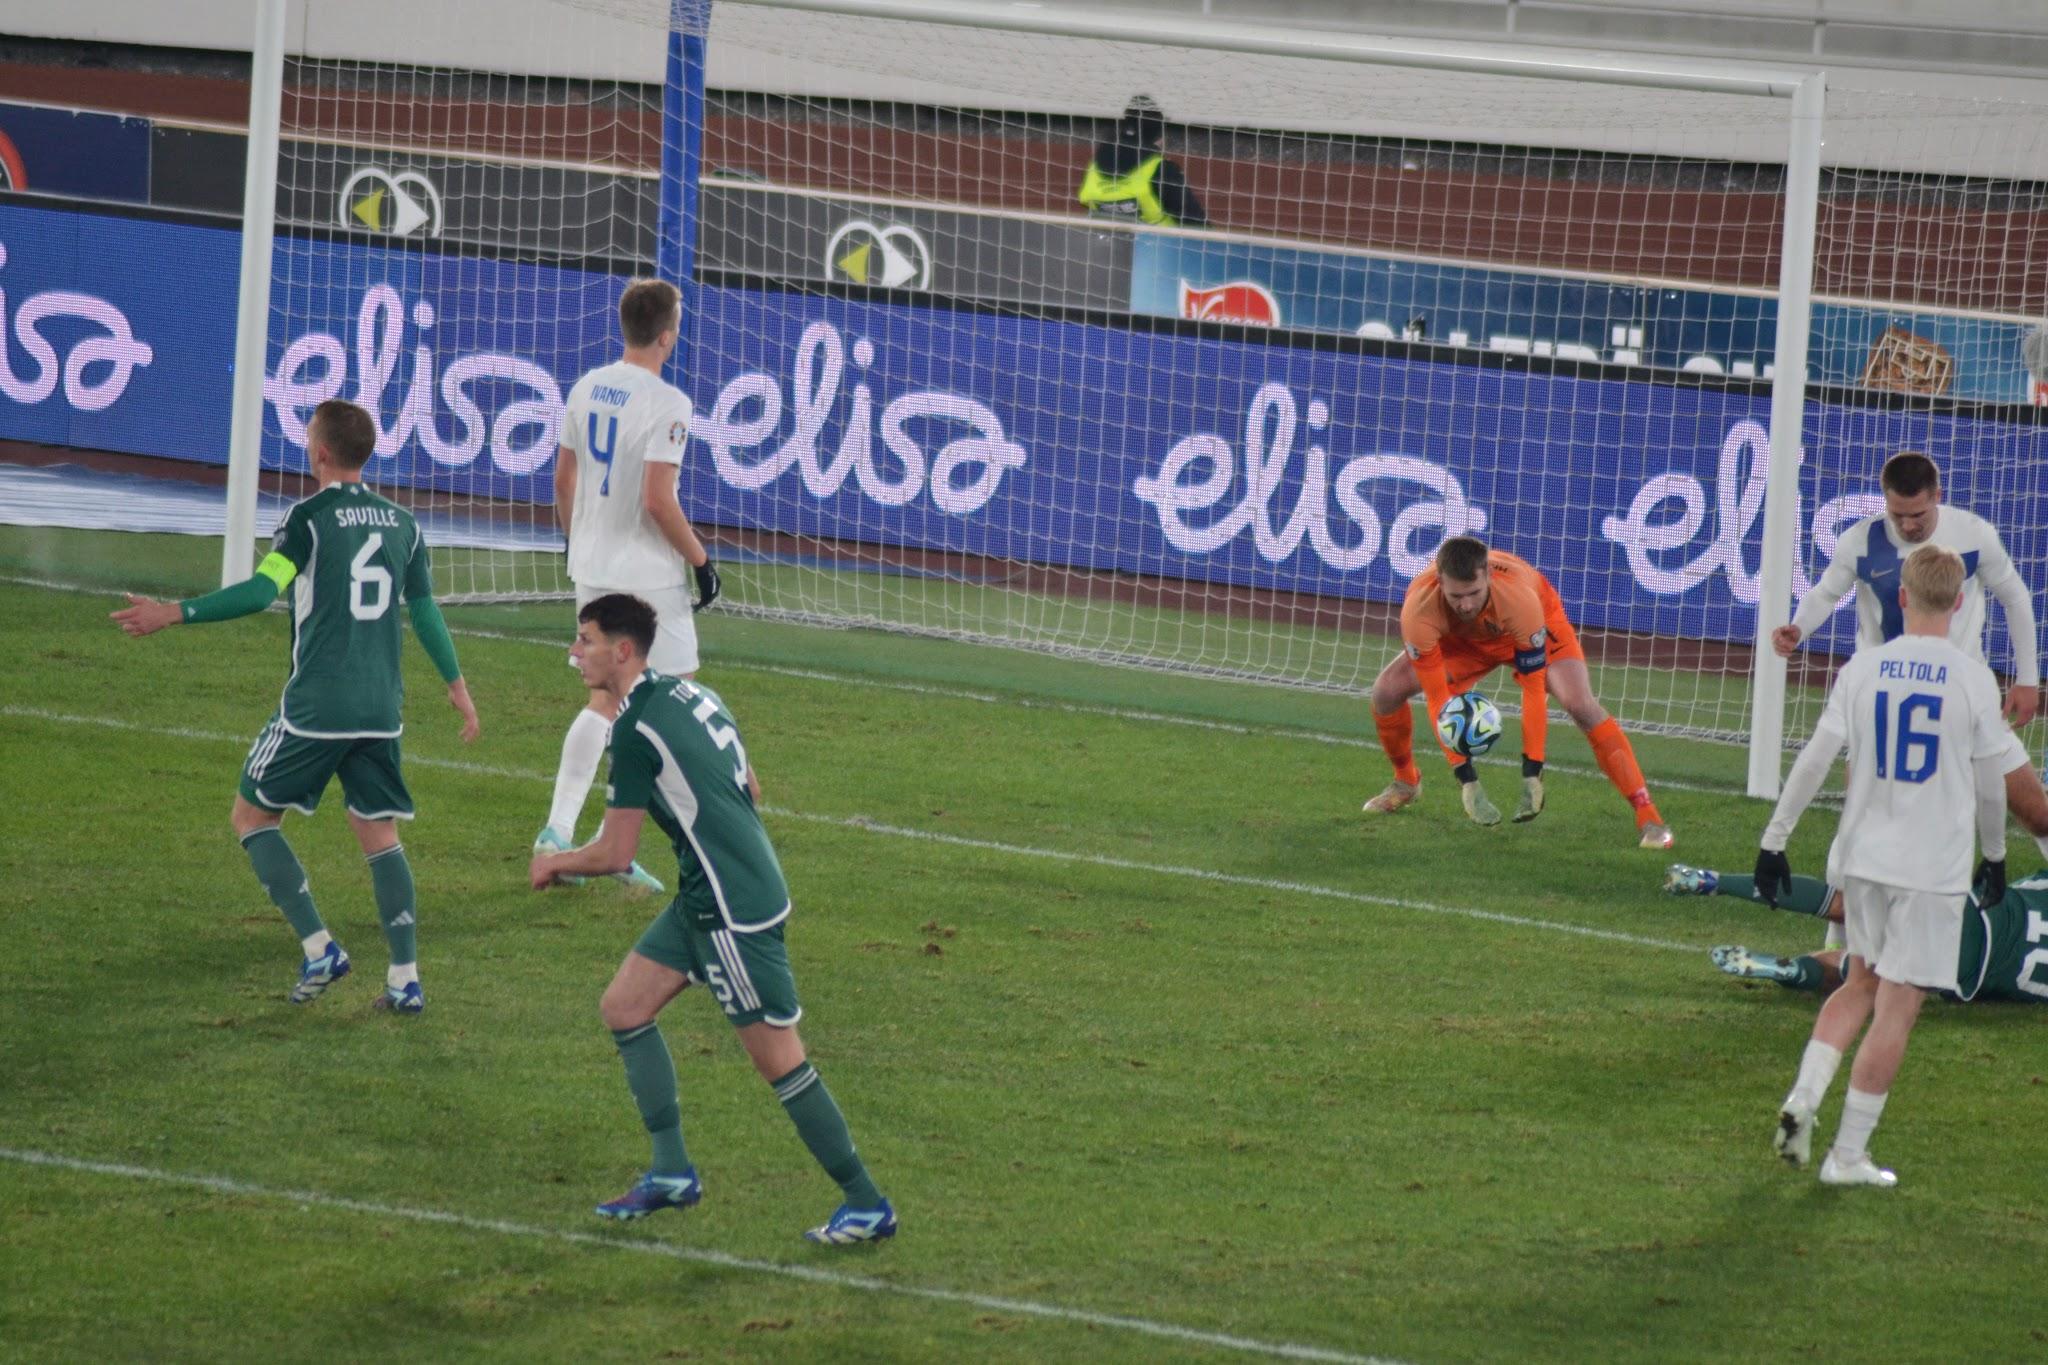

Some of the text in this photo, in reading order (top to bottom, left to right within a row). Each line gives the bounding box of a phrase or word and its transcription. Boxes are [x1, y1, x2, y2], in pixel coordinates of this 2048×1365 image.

[264, 283, 566, 475] elisa
[590, 384, 632, 409] IVANOV
[689, 321, 1027, 514] elisa
[588, 412, 618, 497] 4
[1134, 383, 1487, 577] elisa
[335, 506, 399, 528] SAVILLE
[350, 532, 393, 621] 6
[1879, 660, 1948, 685] PELTOLA
[1874, 690, 1944, 785] 16
[705, 963, 734, 1003] 5
